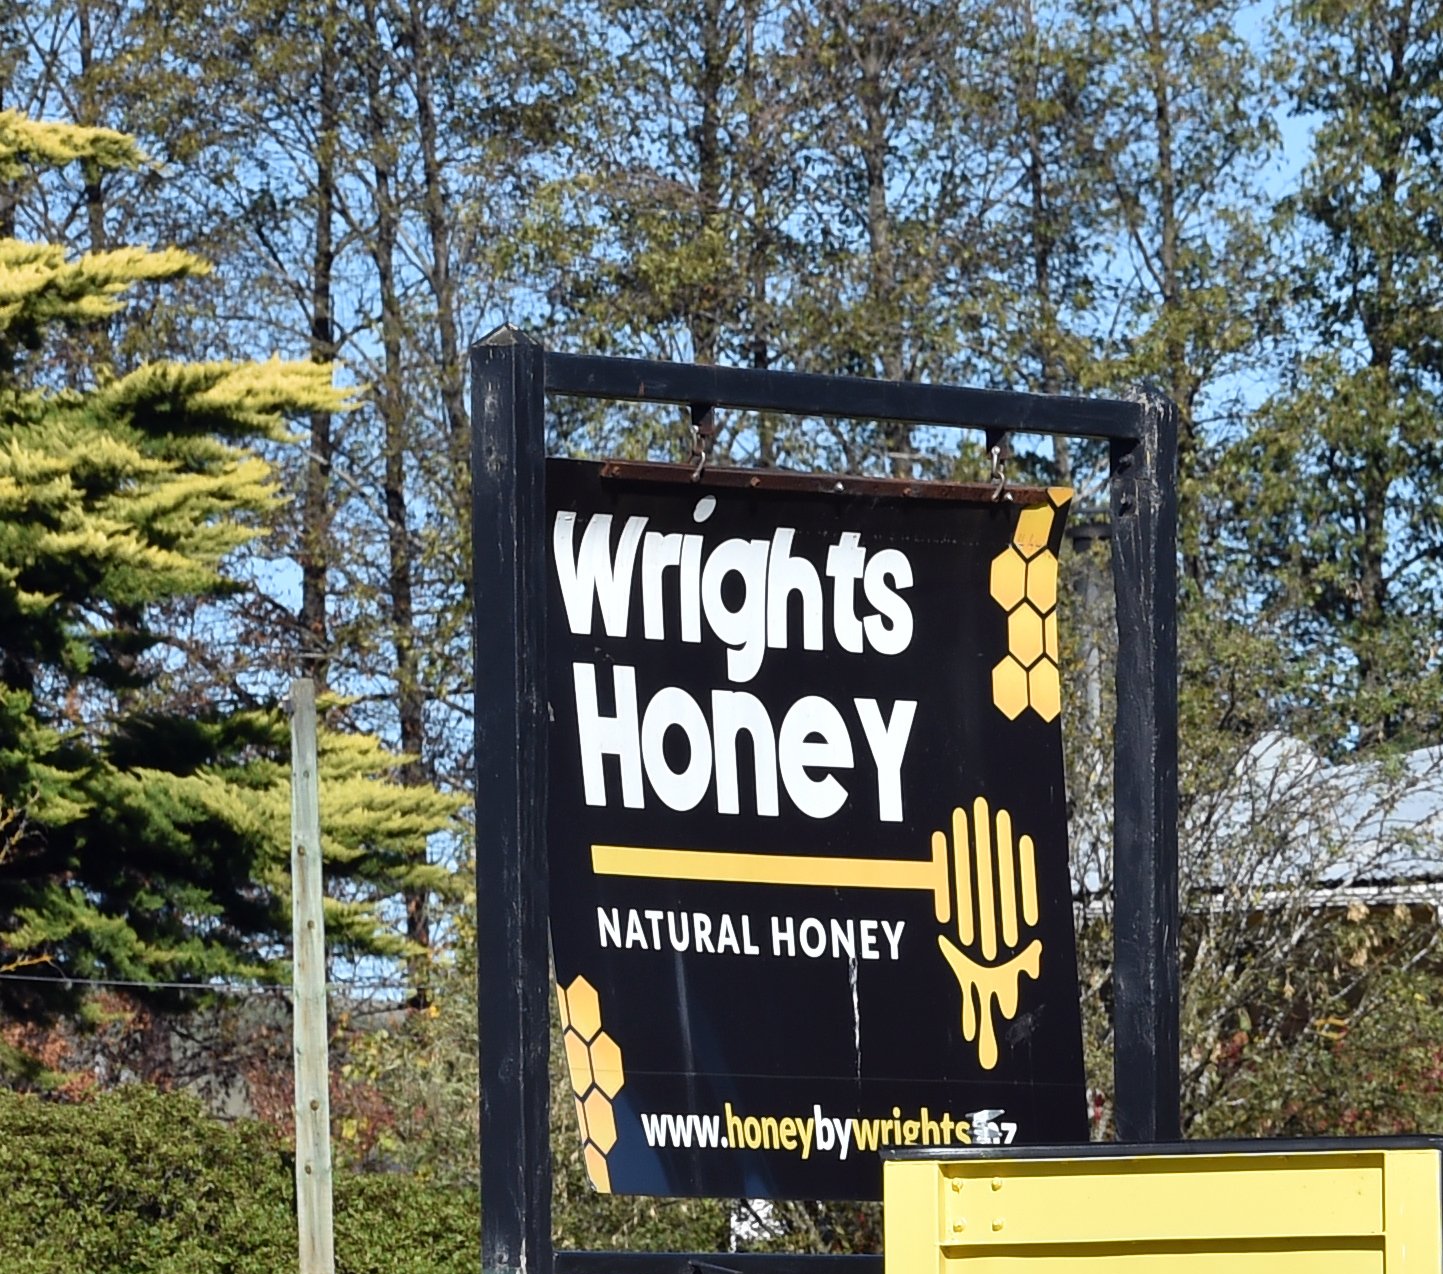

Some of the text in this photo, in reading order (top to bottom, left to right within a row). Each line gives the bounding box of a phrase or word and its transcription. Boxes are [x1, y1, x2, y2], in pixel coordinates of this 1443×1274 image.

[554, 495, 914, 683] Wrights
[597, 906, 906, 961] NATURAL HONEY
